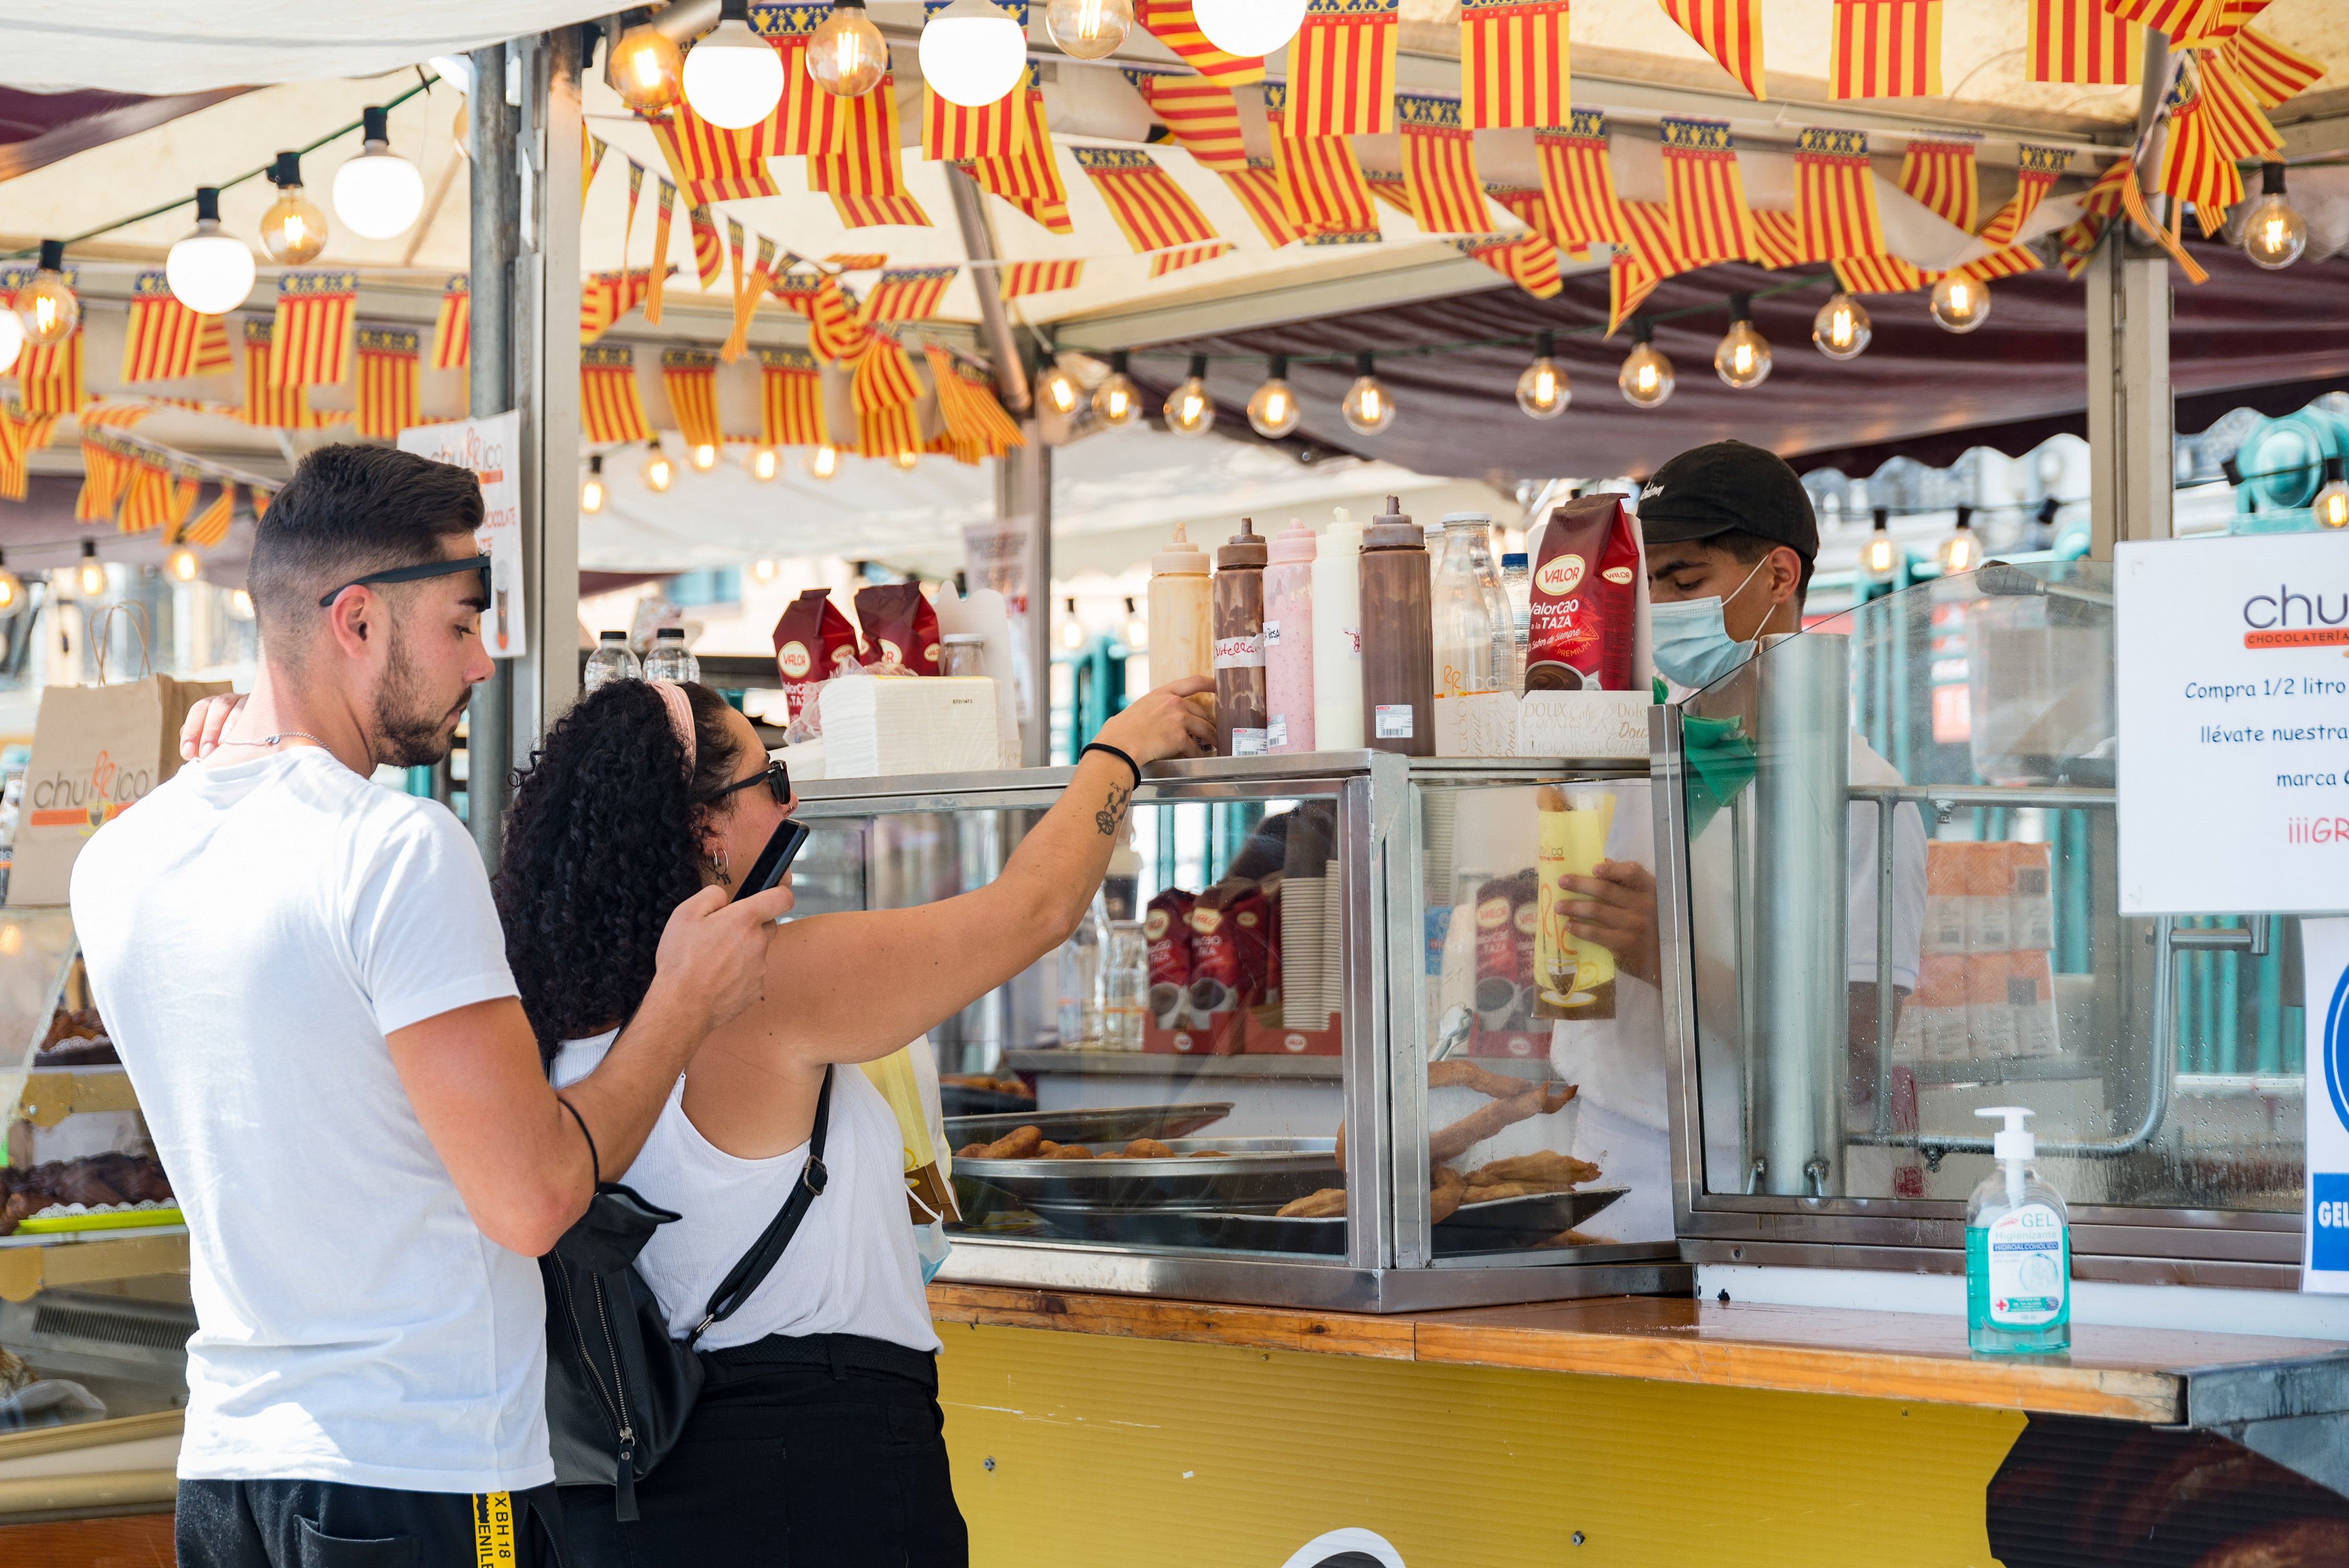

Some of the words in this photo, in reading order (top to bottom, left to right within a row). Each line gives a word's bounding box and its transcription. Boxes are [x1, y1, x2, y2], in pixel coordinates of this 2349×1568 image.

[1545, 566, 1580, 583] VALOR
[1541, 615, 1572, 629] TAZA
[1532, 636, 1546, 650] Sabor
[1547, 635, 1553, 645] de
[1554, 628, 1581, 643] Siempre
[1557, 641, 1591, 657] PREMIUM
[782, 654, 806, 666] VALOR
[2185, 682, 2256, 703] Compra
[2264, 678, 2295, 697] 1/2
[2304, 677, 2345, 694] litro
[1525, 702, 1567, 717] DOUX
[1618, 702, 1646, 718] Dolc
[2201, 725, 2265, 743] llévate
[2276, 771, 2335, 787] marca
[2022, 1213, 2054, 1227] GEL
[1995, 1231, 2057, 1241] Higienizante
